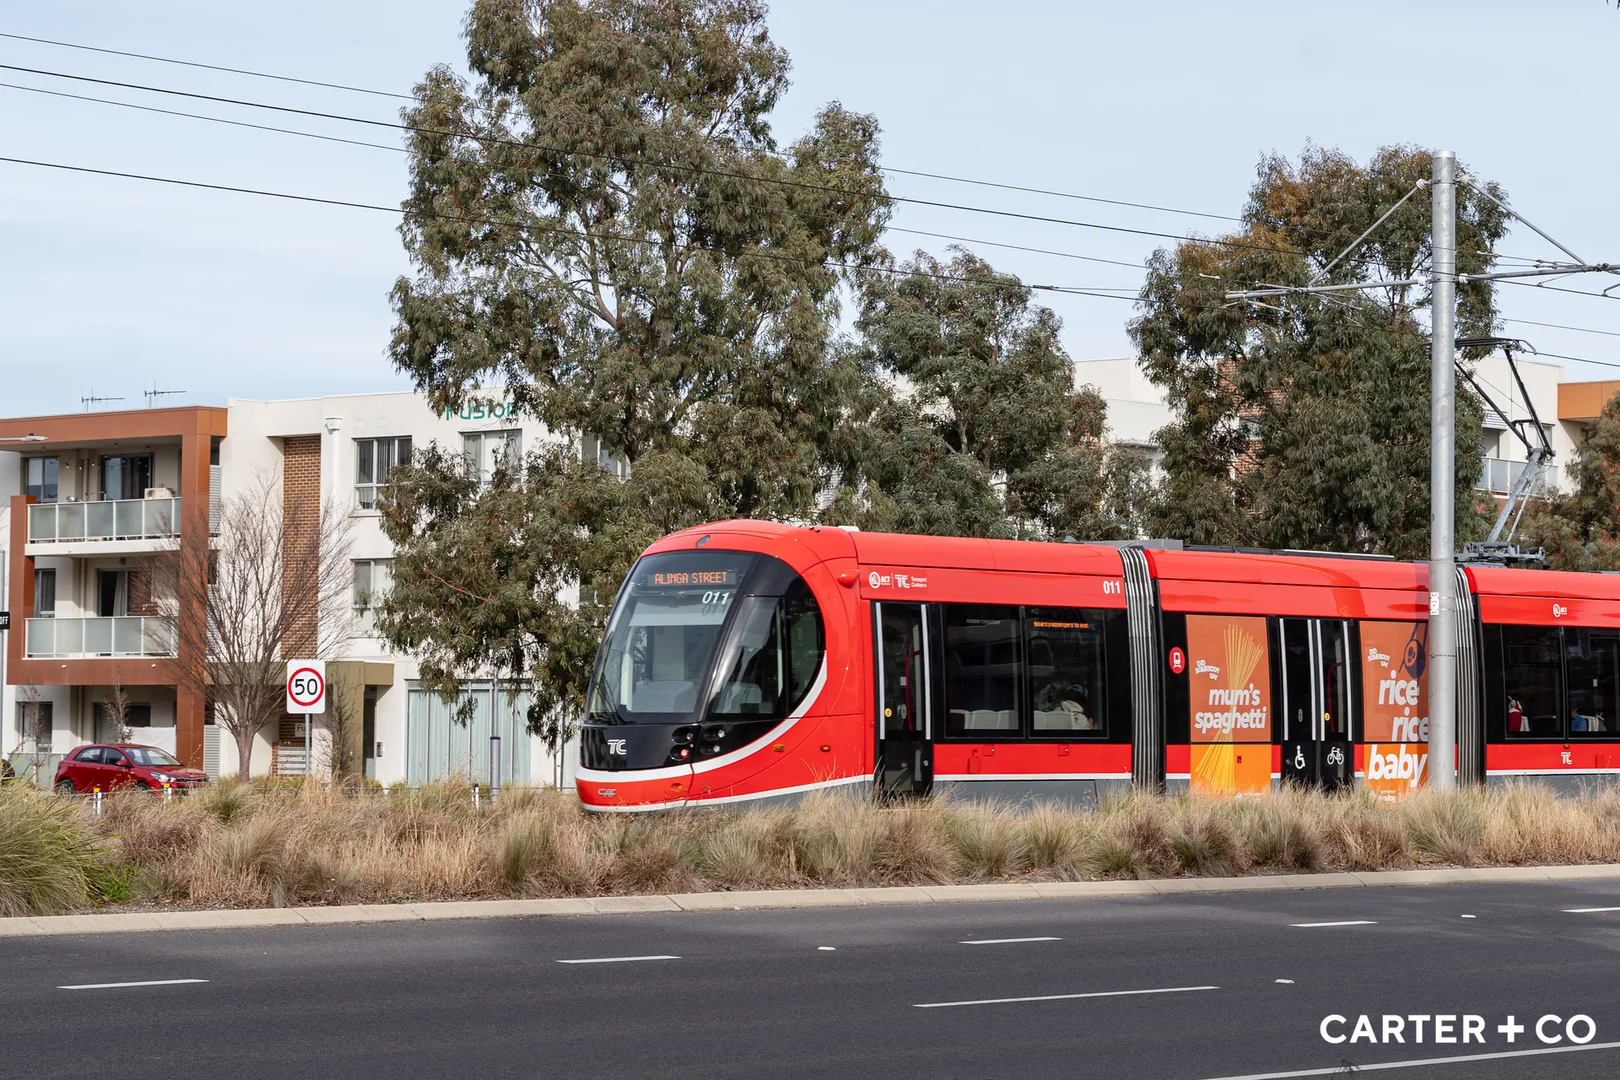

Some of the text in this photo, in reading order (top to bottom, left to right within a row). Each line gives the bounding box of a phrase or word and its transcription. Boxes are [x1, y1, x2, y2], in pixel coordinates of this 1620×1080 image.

[654, 572, 728, 584] ALINGA STREET
[894, 574, 910, 588] TC
[1103, 580, 1120, 594] 011
[702, 591, 730, 604] 011
[294, 678, 318, 695] 50
[1208, 683, 1260, 706] mum's
[1378, 670, 1420, 706] rice
[1194, 706, 1267, 734] spaghetti
[1391, 706, 1428, 742] rice
[608, 739, 627, 755] TC
[1368, 744, 1428, 788] baby
[1560, 752, 1572, 764] TC
